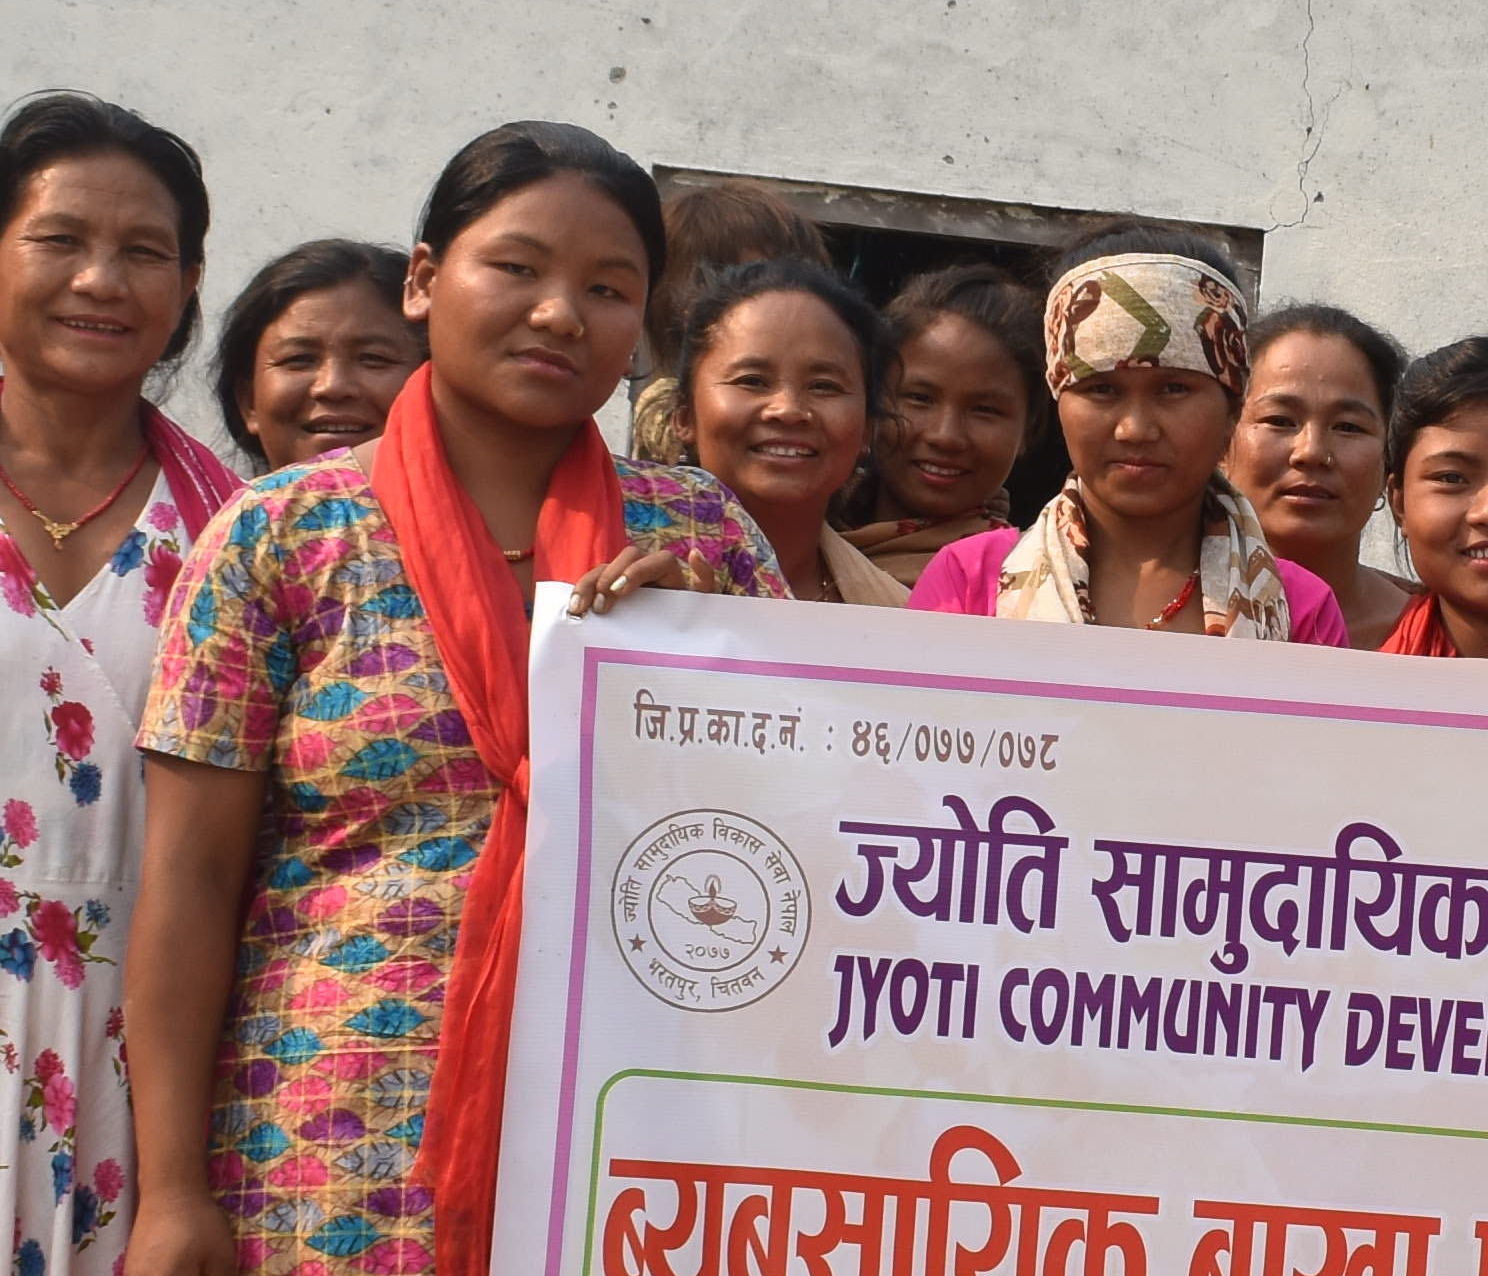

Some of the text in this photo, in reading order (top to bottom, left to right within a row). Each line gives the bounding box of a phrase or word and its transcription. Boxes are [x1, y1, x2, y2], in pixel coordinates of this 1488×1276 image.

[851, 719, 1060, 771] ४६/०७७/०७८
[619, 817, 802, 937] ज्योति सामुदायिक विकास सेवा नेपाल
[835, 795, 1069, 934] ज्योति
[685, 943, 730, 960] २०७७
[711, 965, 765, 999] चितवन
[828, 955, 979, 1048] JYOTI
[999, 967, 1331, 1072] COMMUNITY
